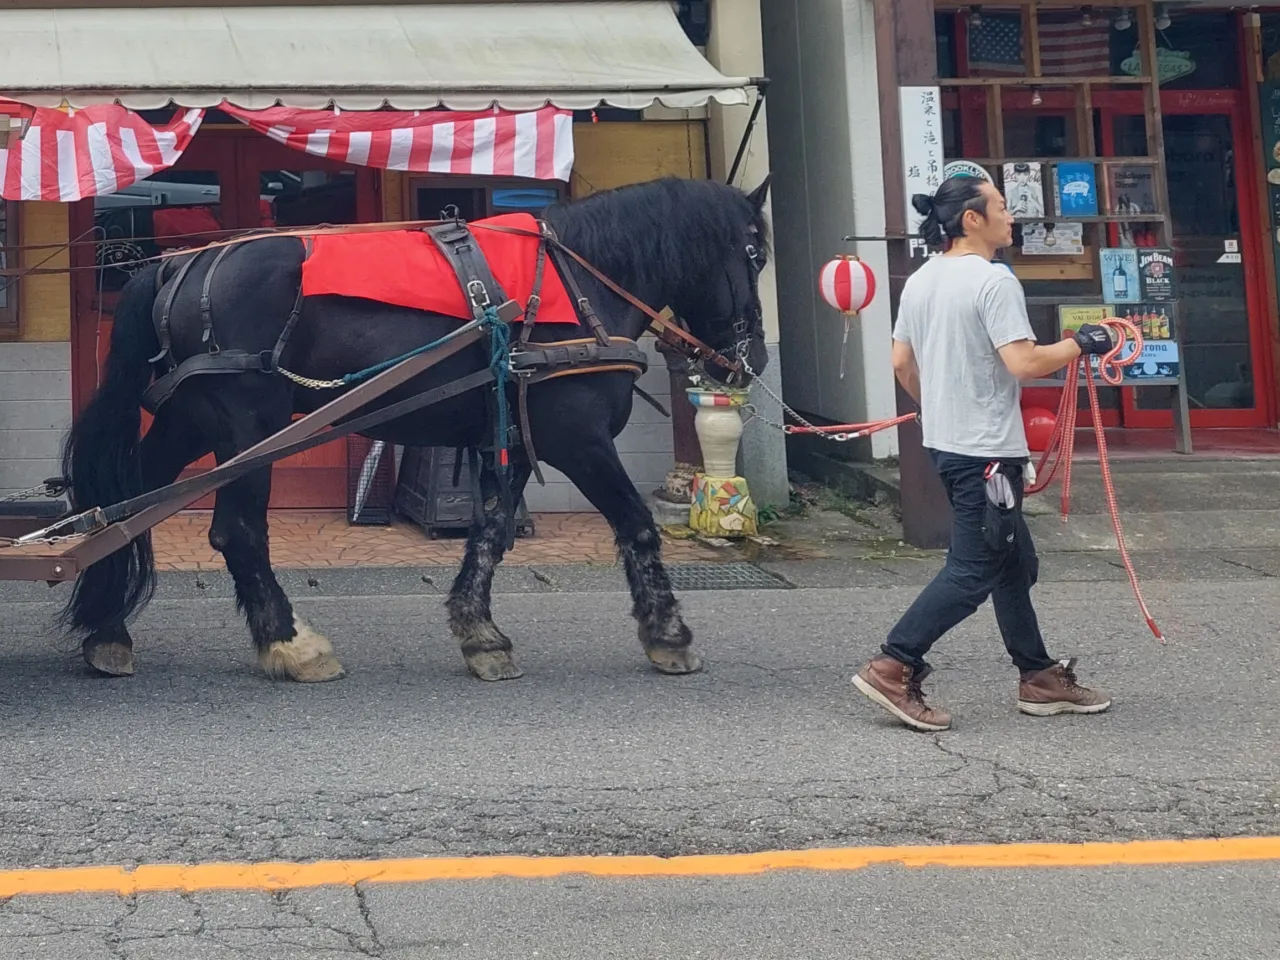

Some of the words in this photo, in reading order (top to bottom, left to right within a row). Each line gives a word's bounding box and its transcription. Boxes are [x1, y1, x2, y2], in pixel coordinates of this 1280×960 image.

[908, 238, 944, 258] 門
[1139, 254, 1154, 267] JIM
[1153, 252, 1174, 267] BEAM
